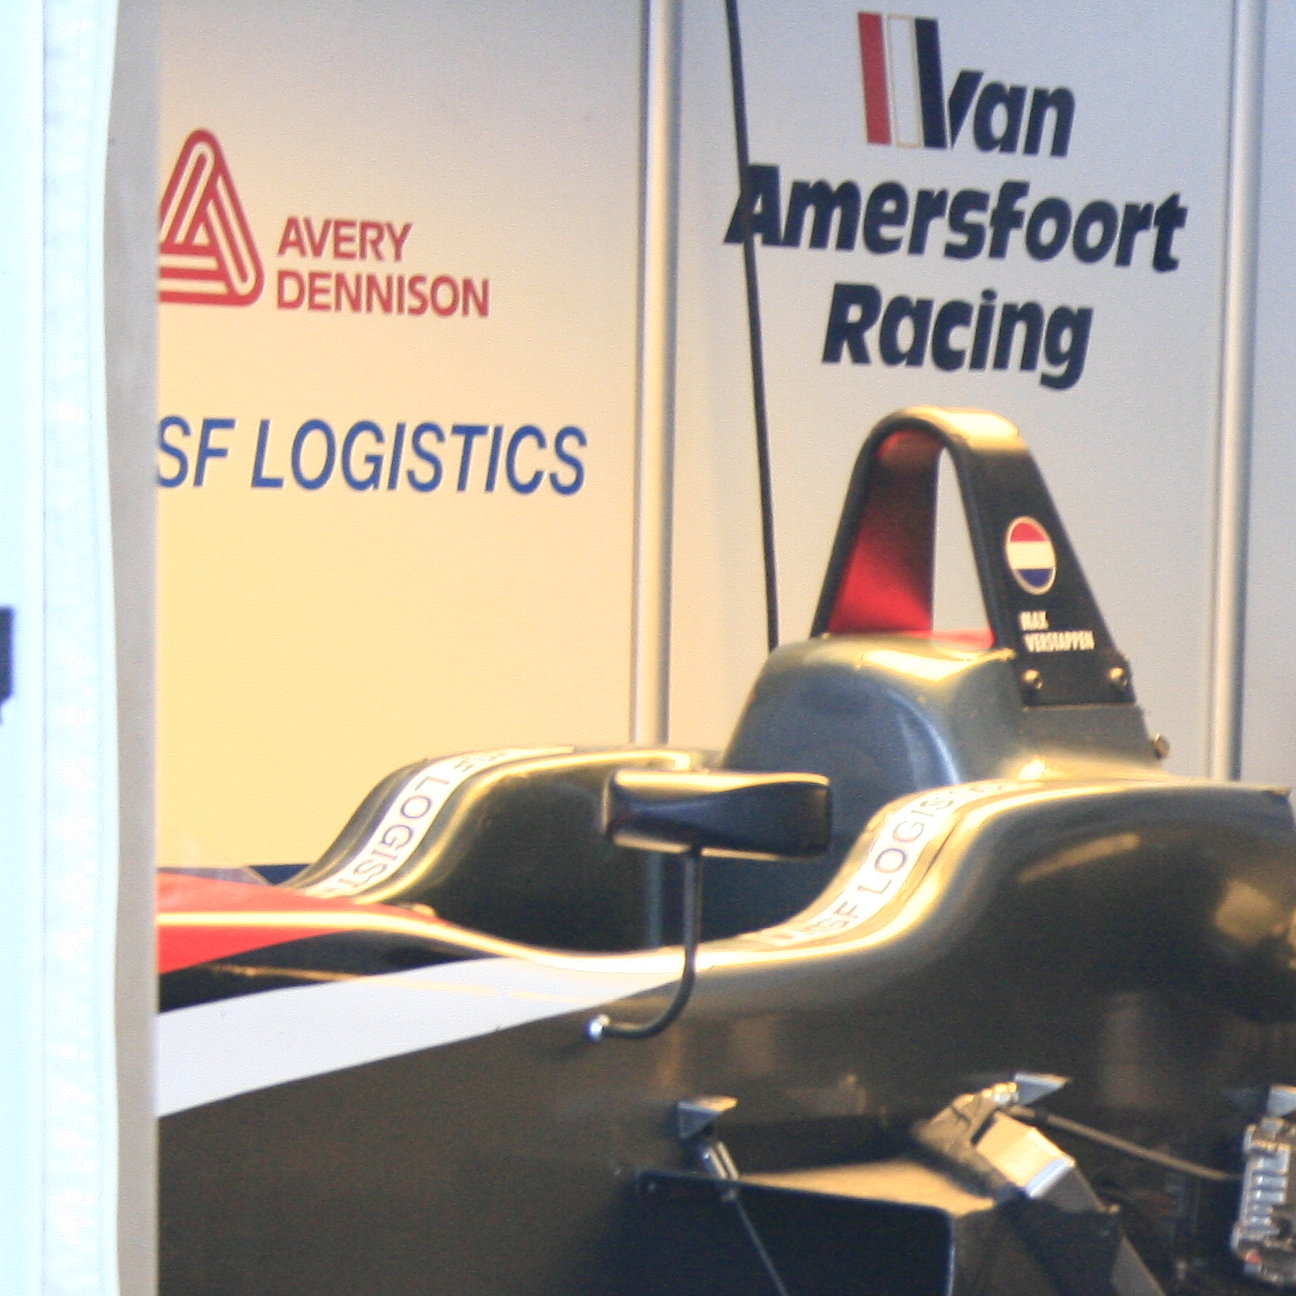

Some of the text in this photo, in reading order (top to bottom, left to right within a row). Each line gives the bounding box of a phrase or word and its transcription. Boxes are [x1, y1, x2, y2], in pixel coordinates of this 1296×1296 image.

[277, 216, 413, 263] AVERY
[723, 163, 1188, 273] Amersfoort
[277, 270, 489, 318] DENNISON
[821, 282, 1094, 391] Racing
[157, 415, 588, 496] SF LOGISTICS
